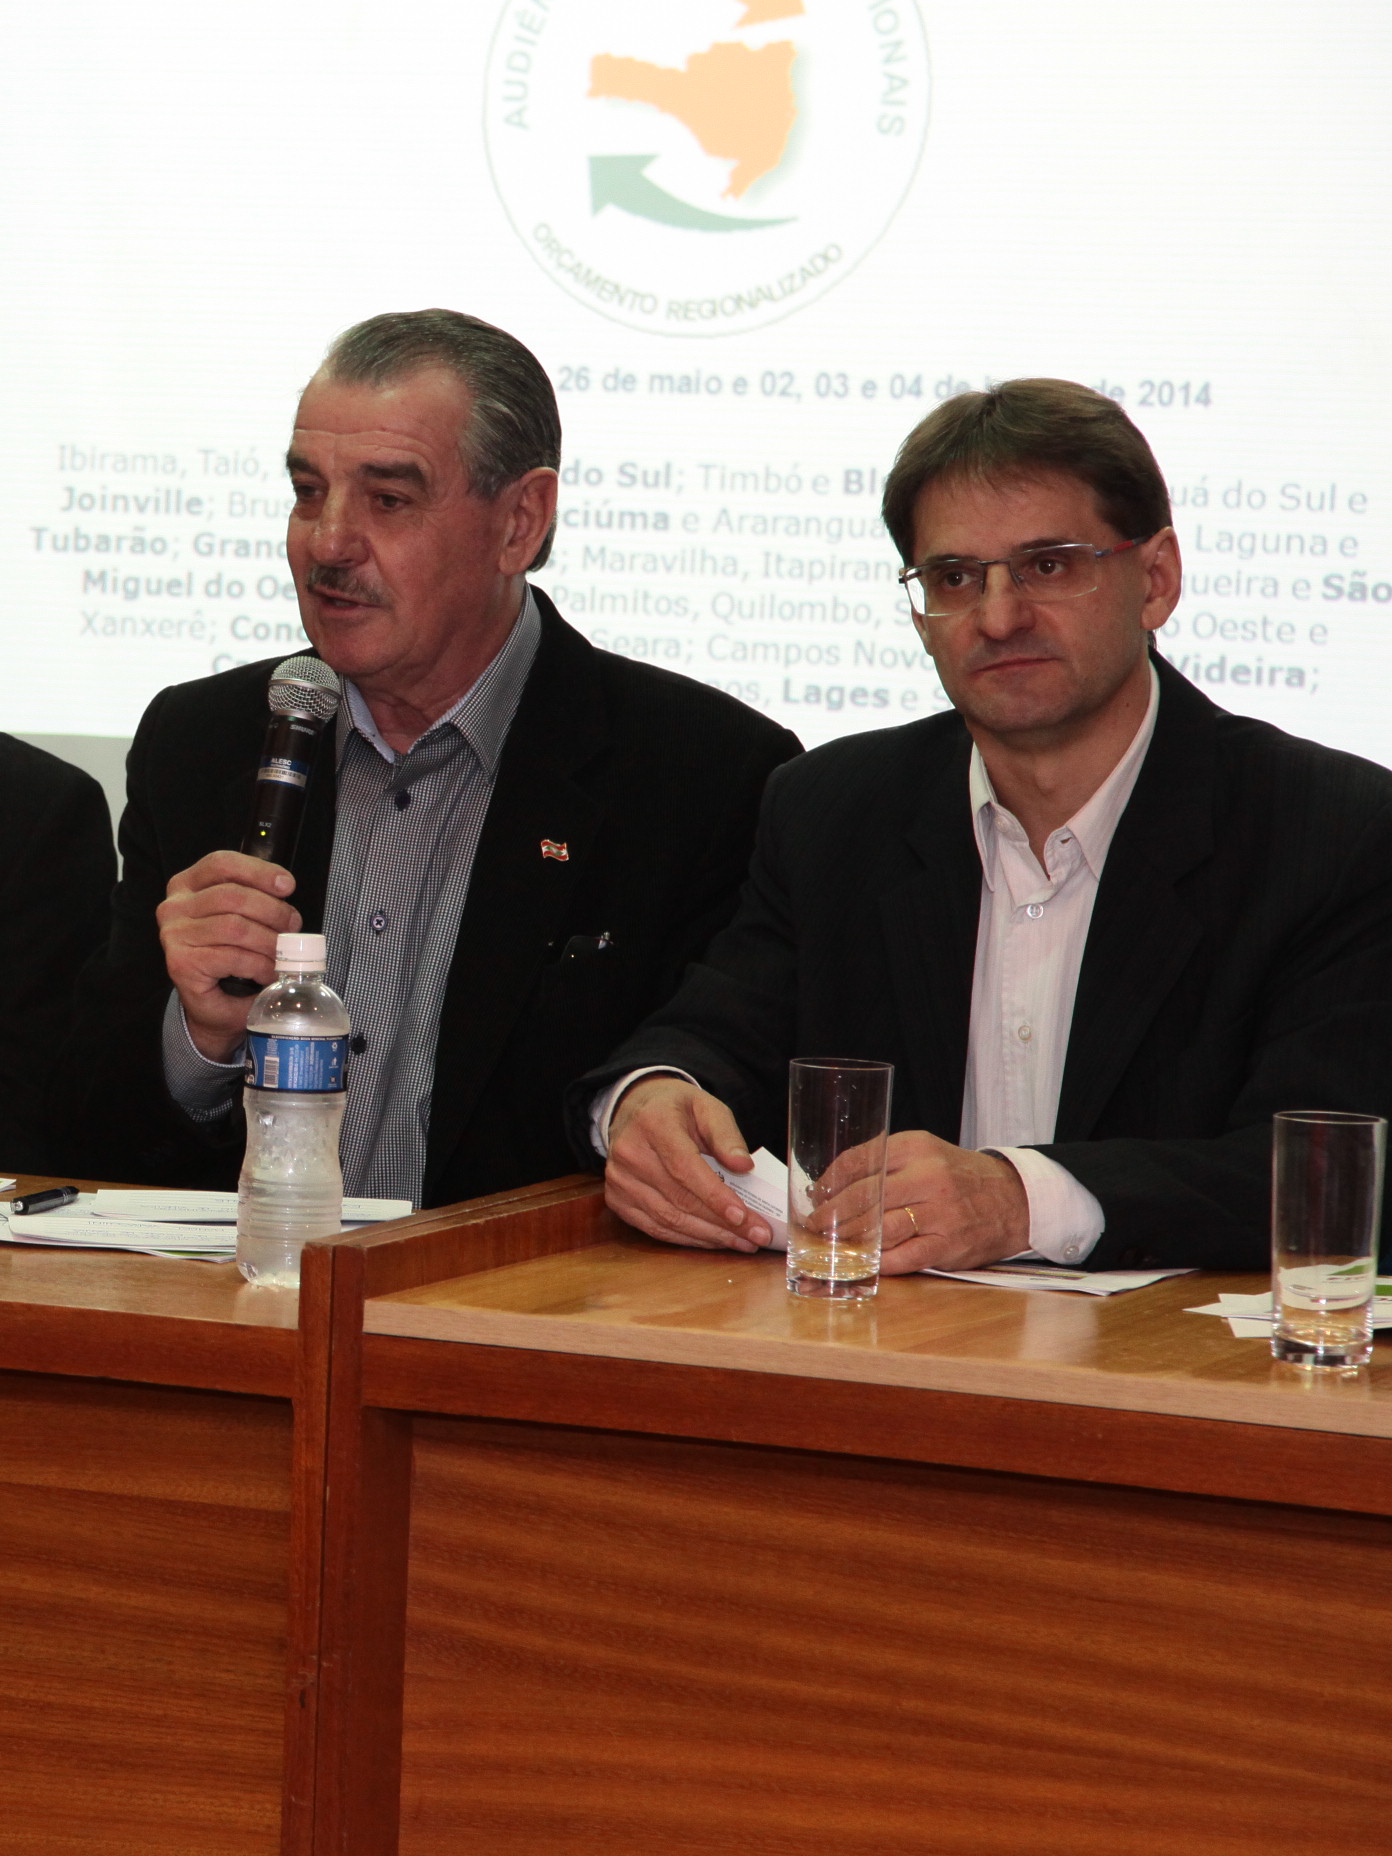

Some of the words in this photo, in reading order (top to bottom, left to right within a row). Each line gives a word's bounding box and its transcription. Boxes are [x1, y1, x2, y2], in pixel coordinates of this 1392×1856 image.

[665, 242, 844, 322] REGIONALIZADO
[558, 365, 591, 393] 26
[601, 367, 638, 394] de
[649, 369, 723, 397] maio
[732, 375, 750, 397] e
[815, 371, 850, 399] 03
[861, 378, 879, 400] e
[889, 373, 924, 400] 04
[1137, 379, 1214, 409] 2014
[58, 444, 188, 480] Ibirama,
[198, 446, 270, 482] Taió,
[560, 458, 604, 488] do
[616, 460, 686, 496] Sul;
[697, 463, 804, 495] Timbó
[811, 473, 831, 495] e
[1221, 478, 1267, 510] do
[1279, 481, 1338, 514] Sul
[1347, 490, 1369, 515] e
[59, 484, 216, 522] Joinville;
[680, 511, 700, 534] e
[1195, 523, 1329, 561] Laguna
[1338, 534, 1360, 558] e
[29, 525, 180, 562] Tubarão;
[581, 544, 751, 583] Maravilha,
[1291, 577, 1312, 601] e
[1321, 569, 1392, 605] São
[79, 608, 218, 645] Xanxerê;
[707, 633, 841, 669] Campos
[82, 567, 194, 602] Miguel
[204, 571, 246, 600] do
[552, 584, 700, 623] Palmitos,
[710, 590, 882, 630] Quilombo,
[1192, 610, 1297, 645] Oeste
[1309, 621, 1329, 646] e
[782, 676, 892, 711] Lages
[899, 687, 919, 711] e
